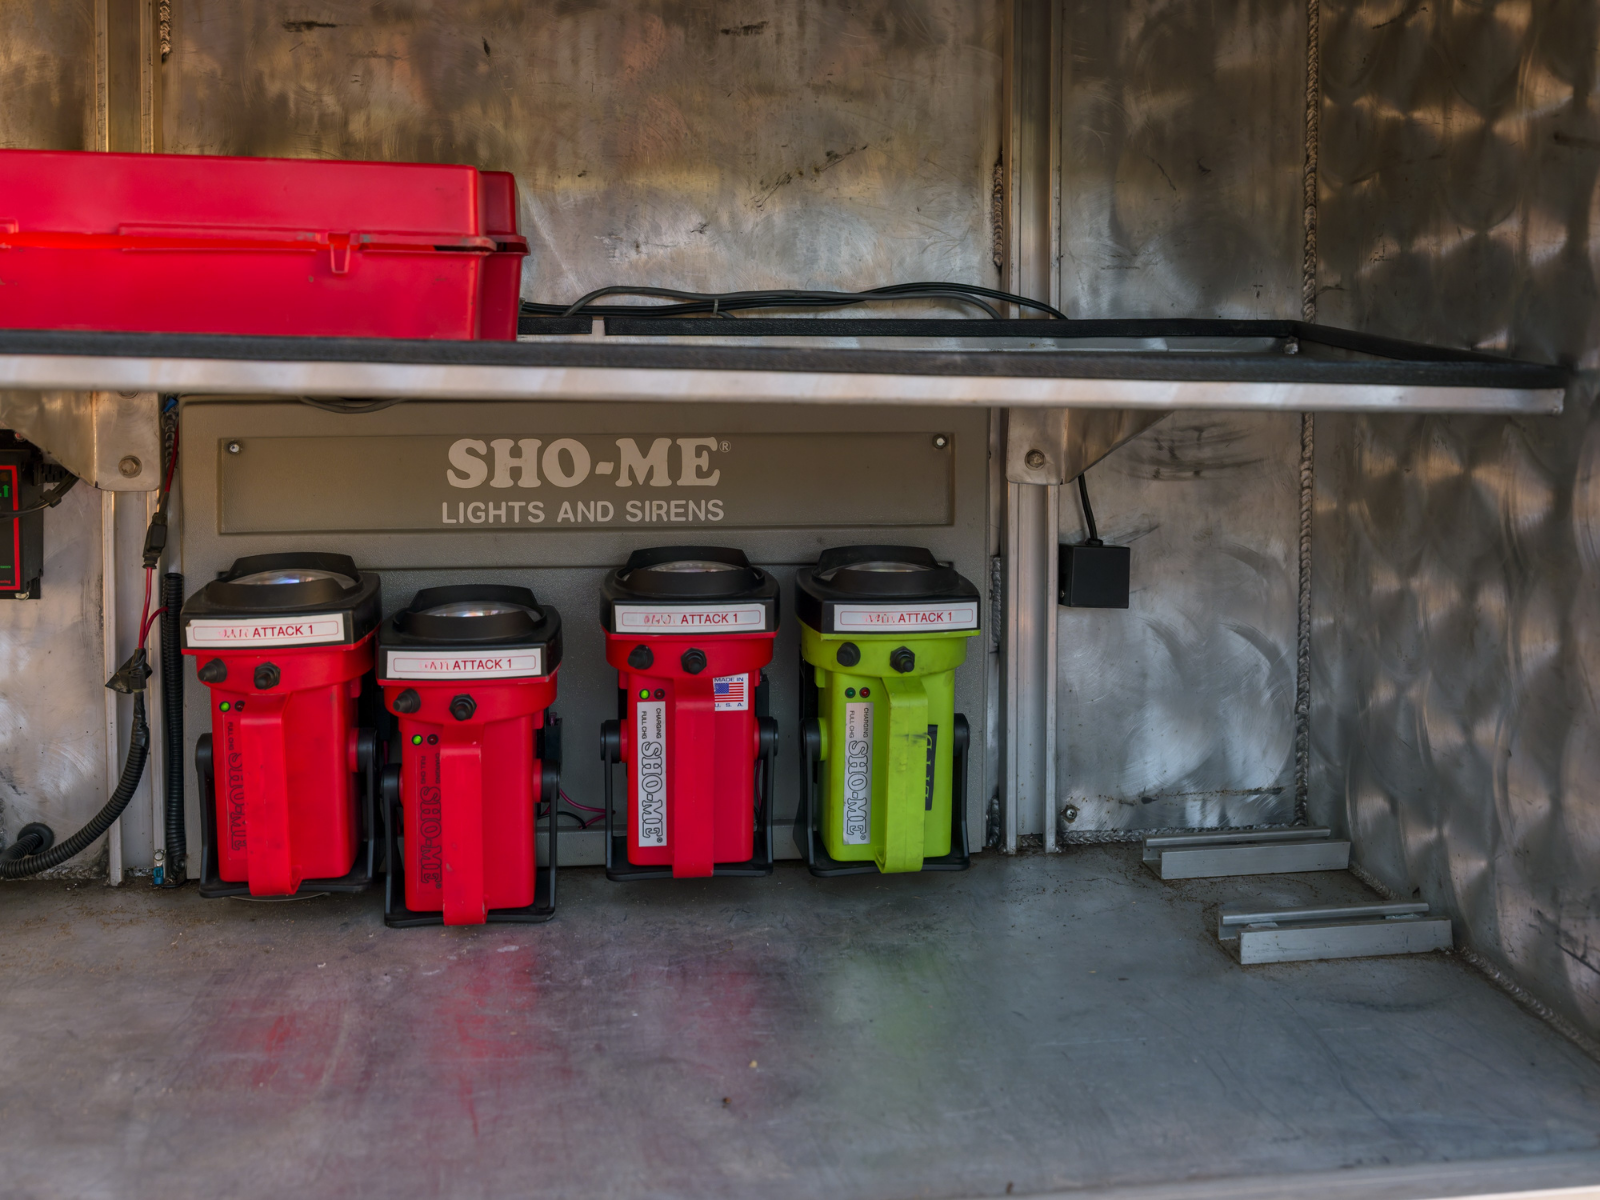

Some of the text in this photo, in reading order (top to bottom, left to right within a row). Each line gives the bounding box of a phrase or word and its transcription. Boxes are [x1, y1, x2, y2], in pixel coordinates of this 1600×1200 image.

[442, 499, 724, 524] LIGHTS AND SIRENS
[680, 613, 729, 624] ATTACK
[733, 613, 738, 623] 1
[898, 612, 944, 623] ATTACK
[948, 612, 952, 622] 1
[252, 625, 303, 638] ATTACK
[308, 624, 313, 634] 1
[452, 658, 503, 670] ATTACK
[507, 658, 512, 668] 1
